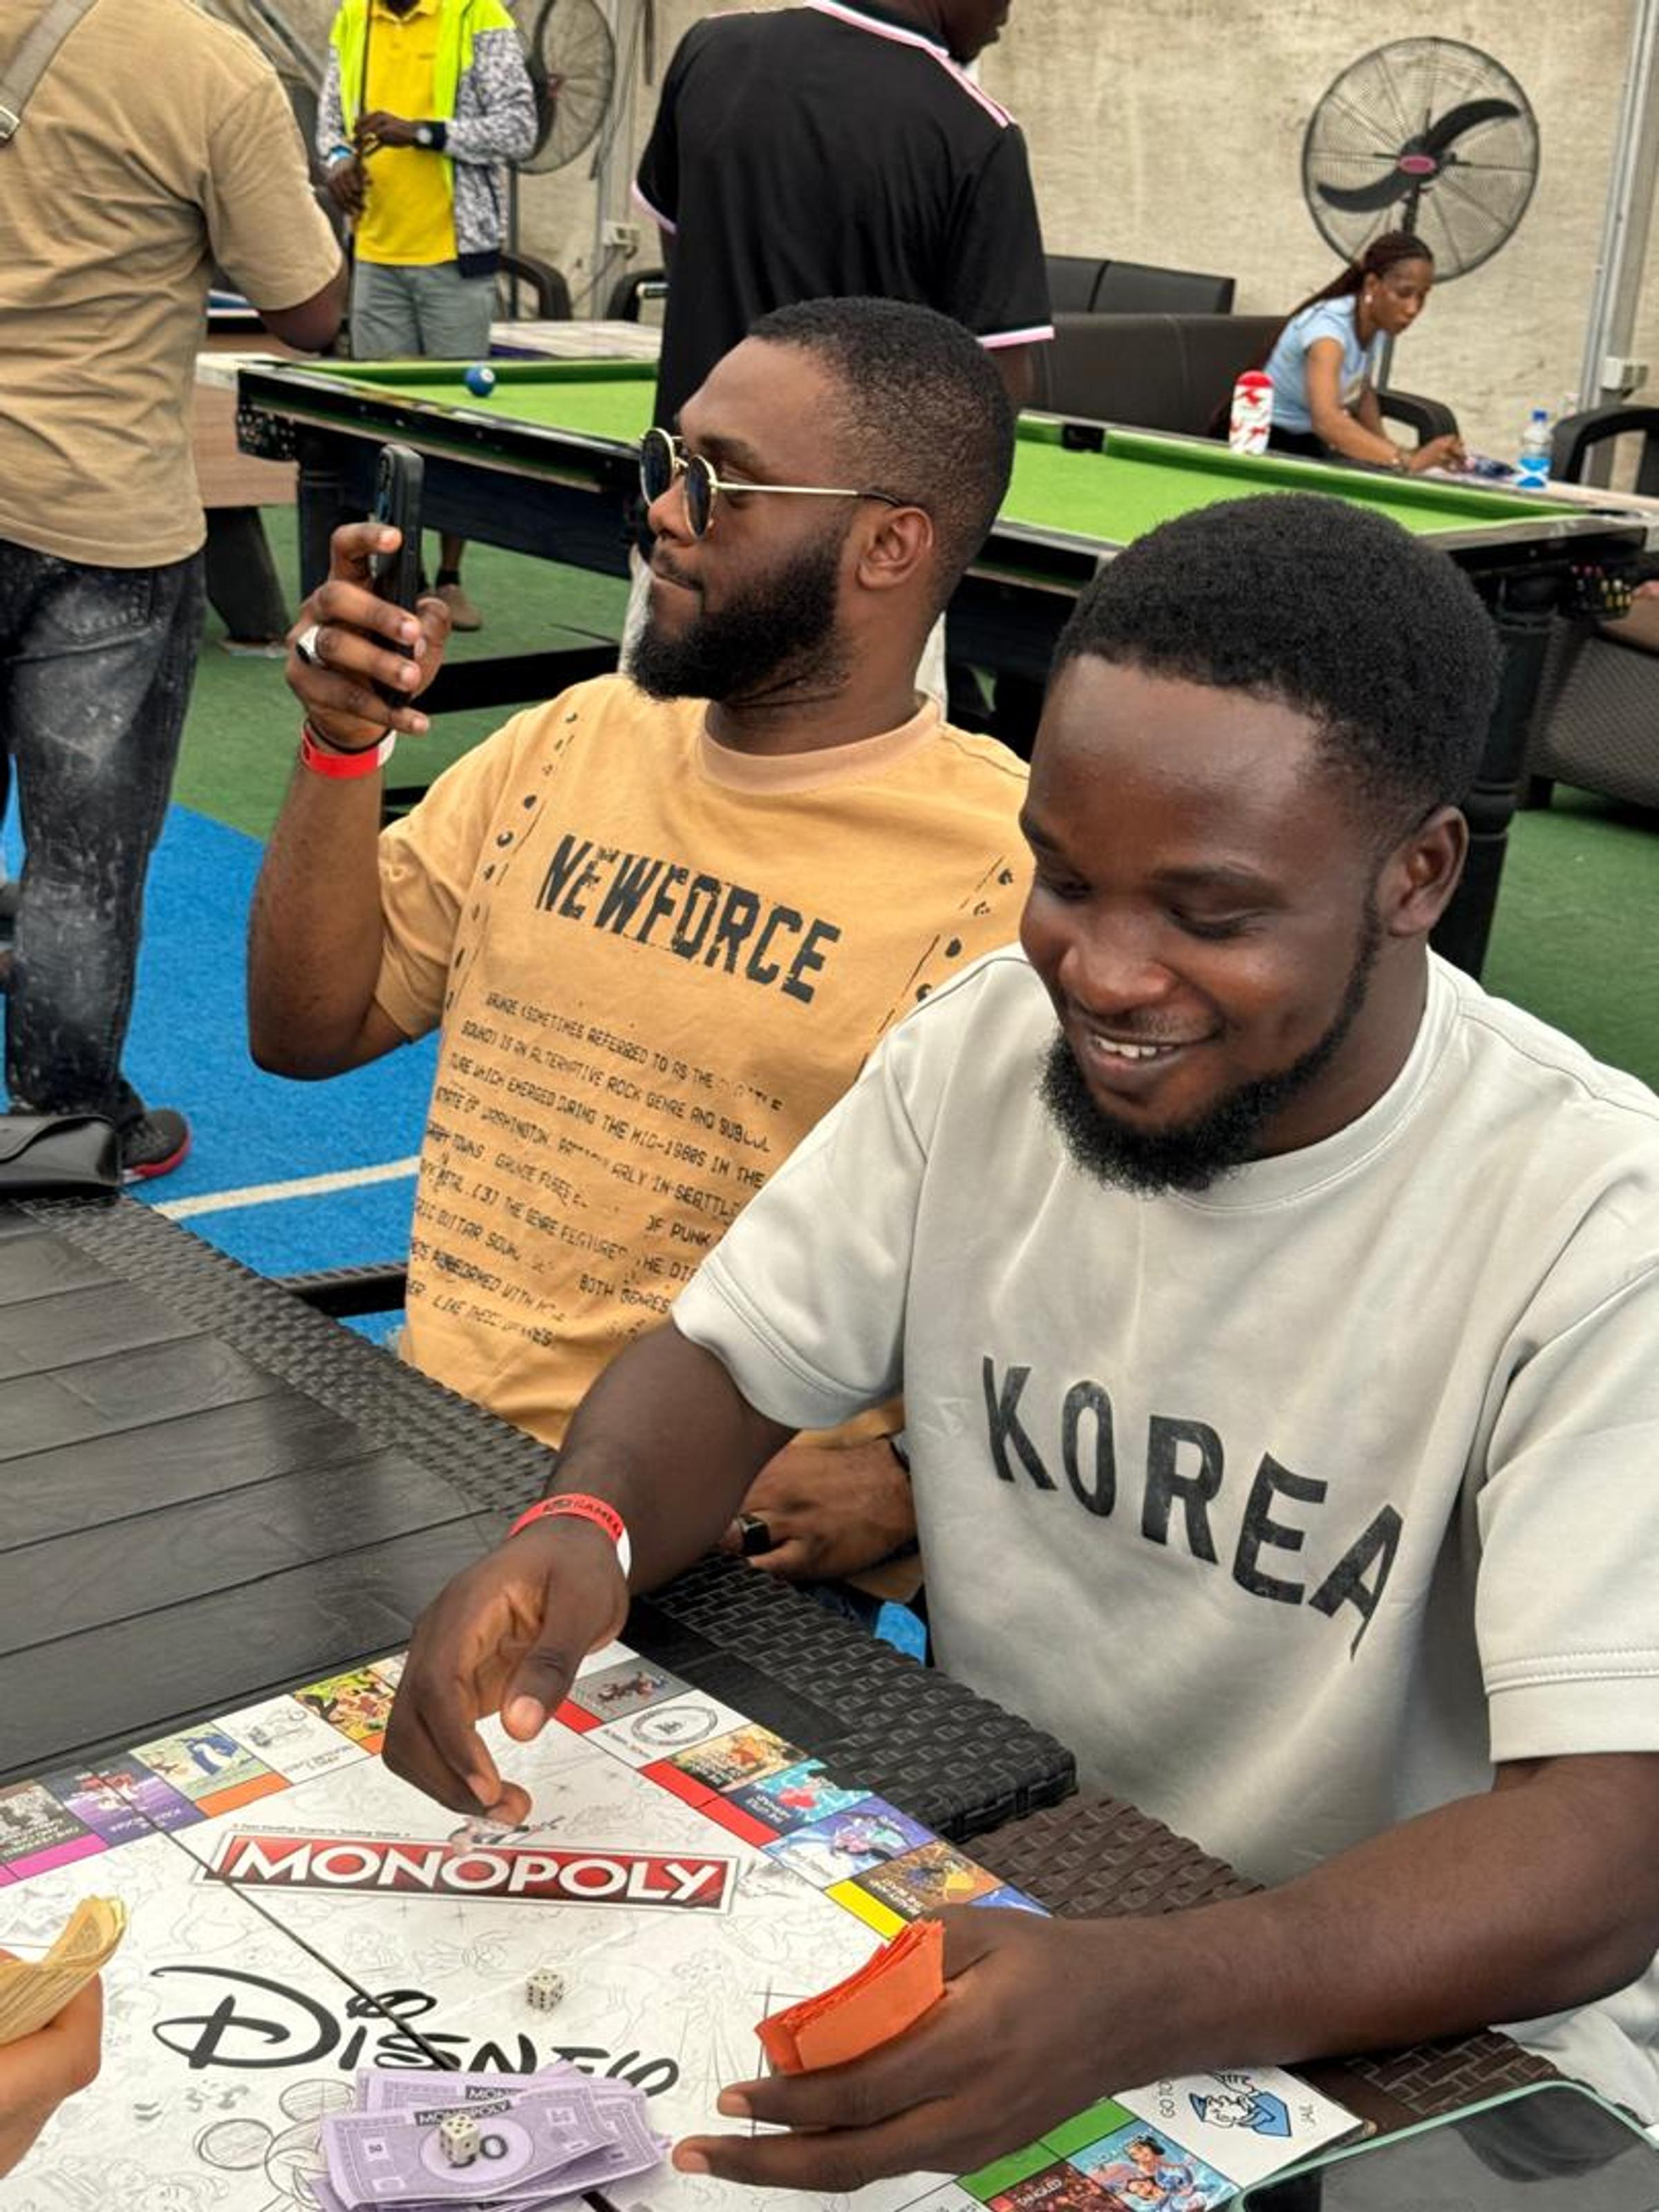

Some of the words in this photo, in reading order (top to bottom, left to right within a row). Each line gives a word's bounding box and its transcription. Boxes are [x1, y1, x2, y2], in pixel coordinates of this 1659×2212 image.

[535, 834, 841, 1004] NEWFORCE
[500, 1033, 514, 1051] IS
[606, 1076, 641, 1102] ROCK
[646, 1091, 686, 1120] GENRE
[690, 1106, 715, 1130] AND
[588, 1027, 648, 1065] REFERRED
[653, 1052, 668, 1072] TO
[672, 1060, 688, 1080] AS
[692, 1067, 713, 1089] THE
[602, 1114, 629, 1140] THE
[711, 1156, 731, 1176] IN
[736, 1167, 766, 1190] THE
[670, 1222, 711, 1246] PUNK
[578, 1274, 616, 1297] BOTH
[982, 1355, 1404, 1662] KOREA
[228, 1839, 720, 1901] MONOPOLY
[1160, 2098, 1175, 2119] GO
